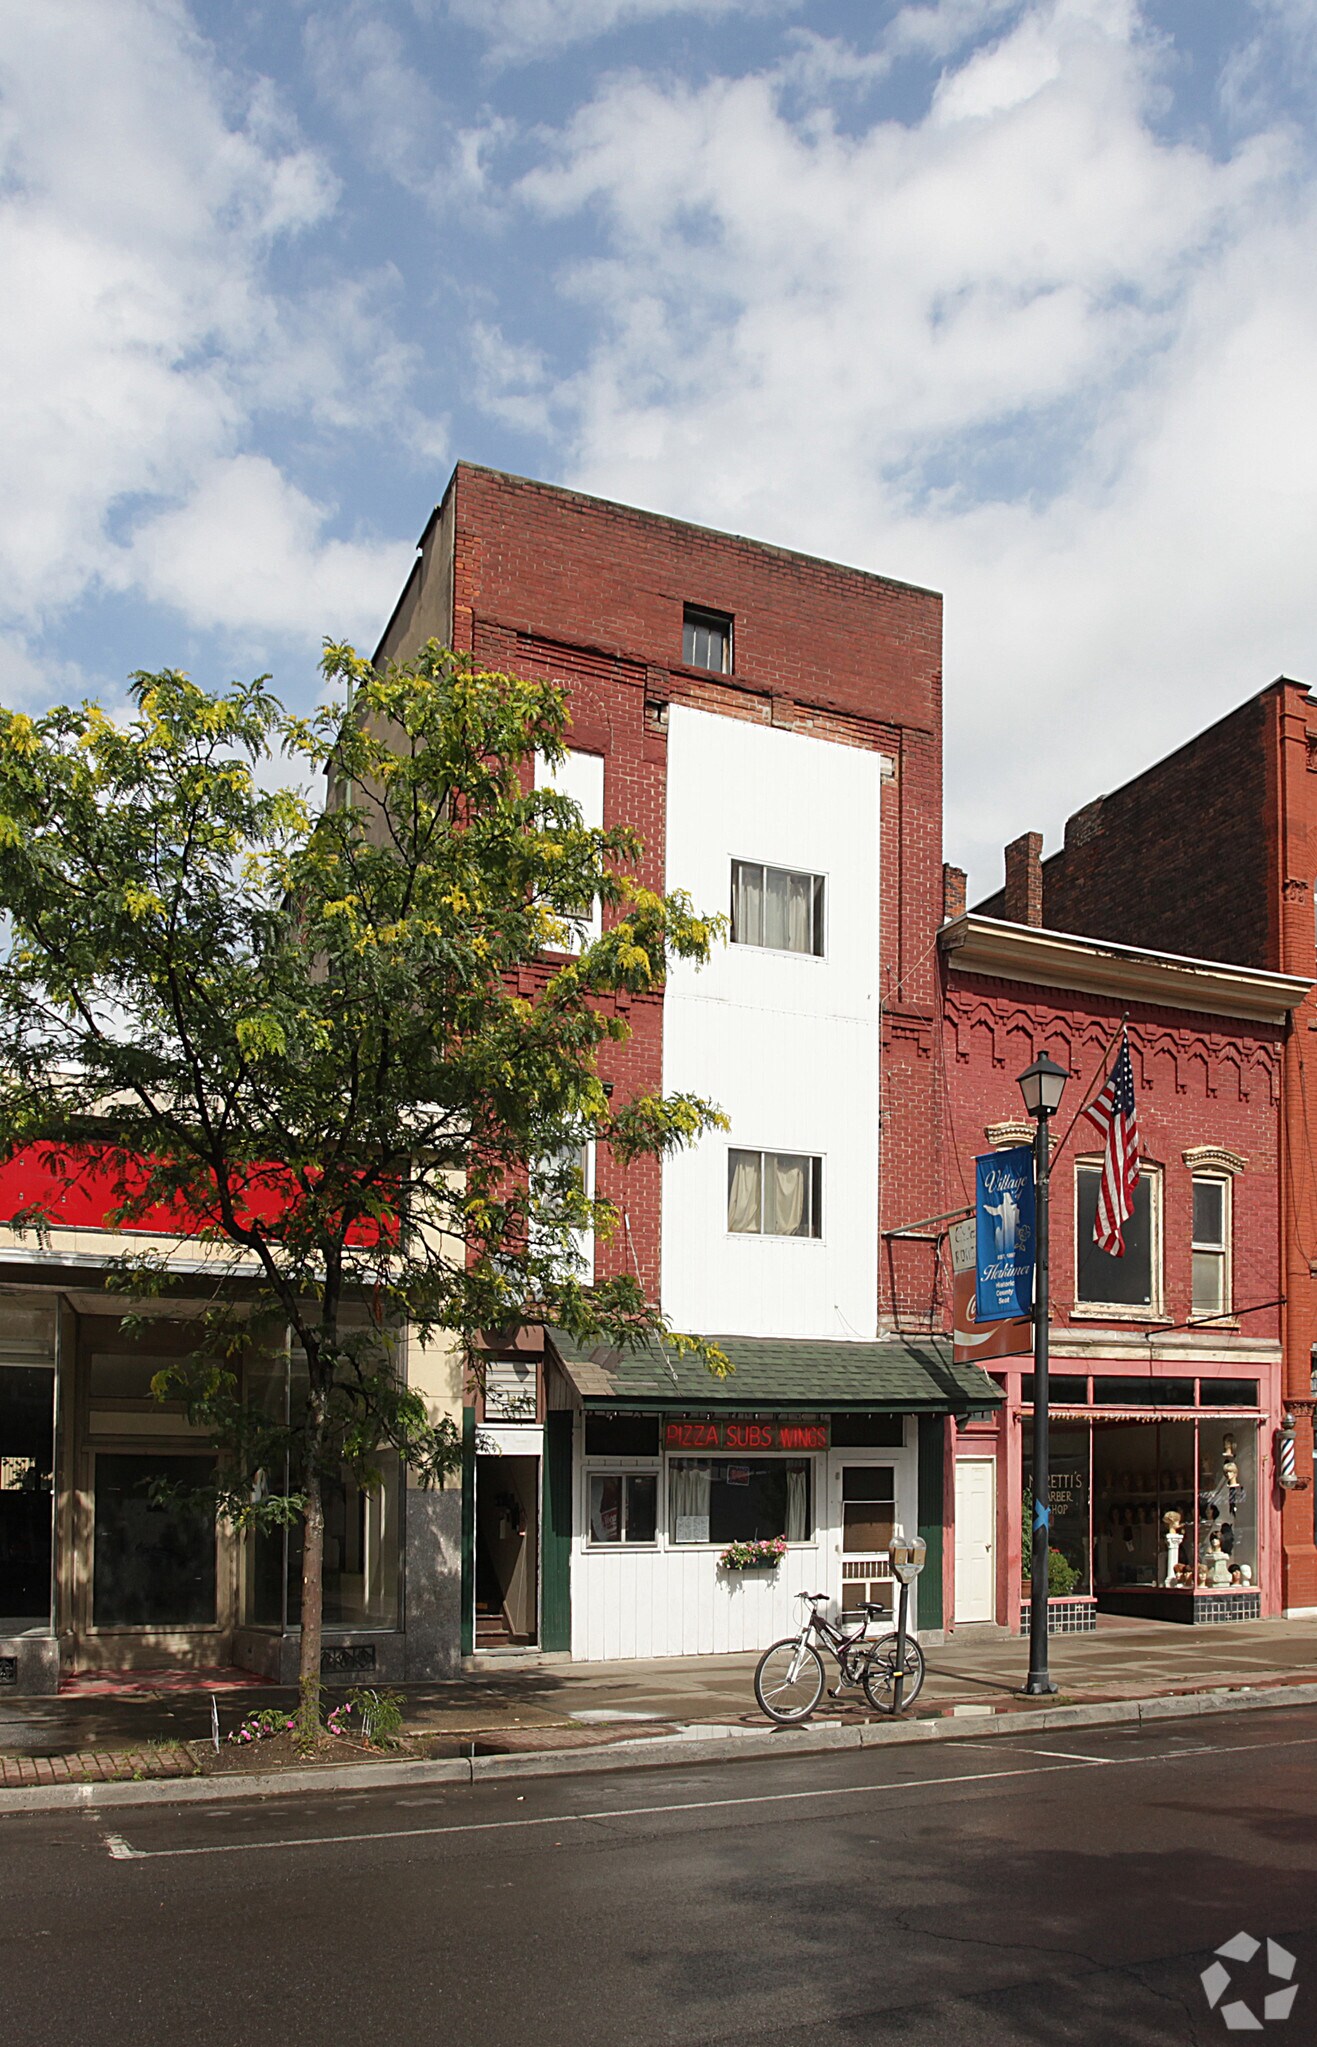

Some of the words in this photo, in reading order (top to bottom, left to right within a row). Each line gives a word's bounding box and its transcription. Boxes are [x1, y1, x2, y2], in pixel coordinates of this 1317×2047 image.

[985, 1170, 1027, 1194] Village
[980, 1262, 1030, 1281] Herkimer
[667, 1425, 718, 1445] PIZZA
[726, 1425, 772, 1447] SUBS
[780, 1426, 826, 1448] WINGS
[1051, 1504, 1069, 1515] HOP
